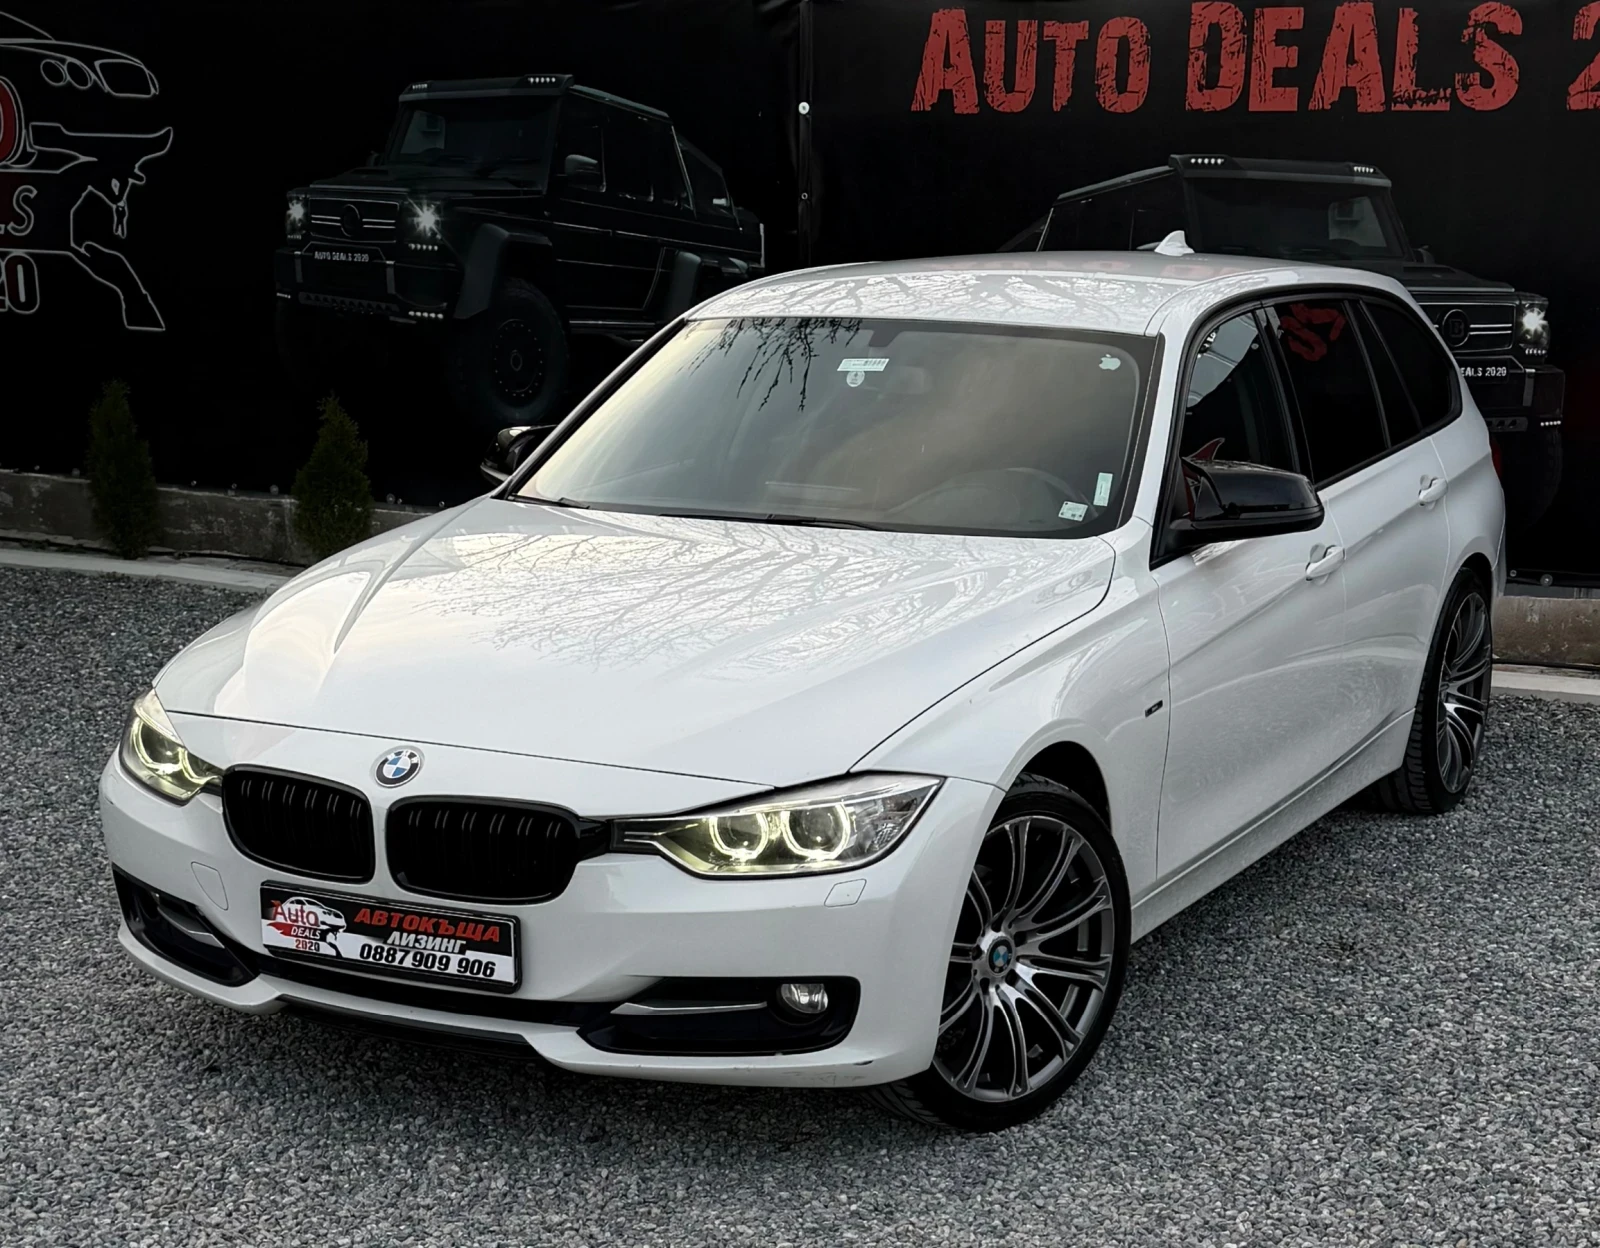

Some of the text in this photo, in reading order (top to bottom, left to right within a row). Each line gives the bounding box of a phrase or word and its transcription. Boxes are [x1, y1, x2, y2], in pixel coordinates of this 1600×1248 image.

[911, 8, 1151, 113] AUTO
[1185, 1, 1523, 112] DEALS
[1460, 366, 1507, 377] EALS 2020
[290, 926, 321, 940] DEALS
[354, 908, 500, 942] АВТОКЪЩА
[295, 938, 320, 952] 2020
[387, 931, 467, 954] ЛИЗИНГ
[456, 957, 497, 978] 906
